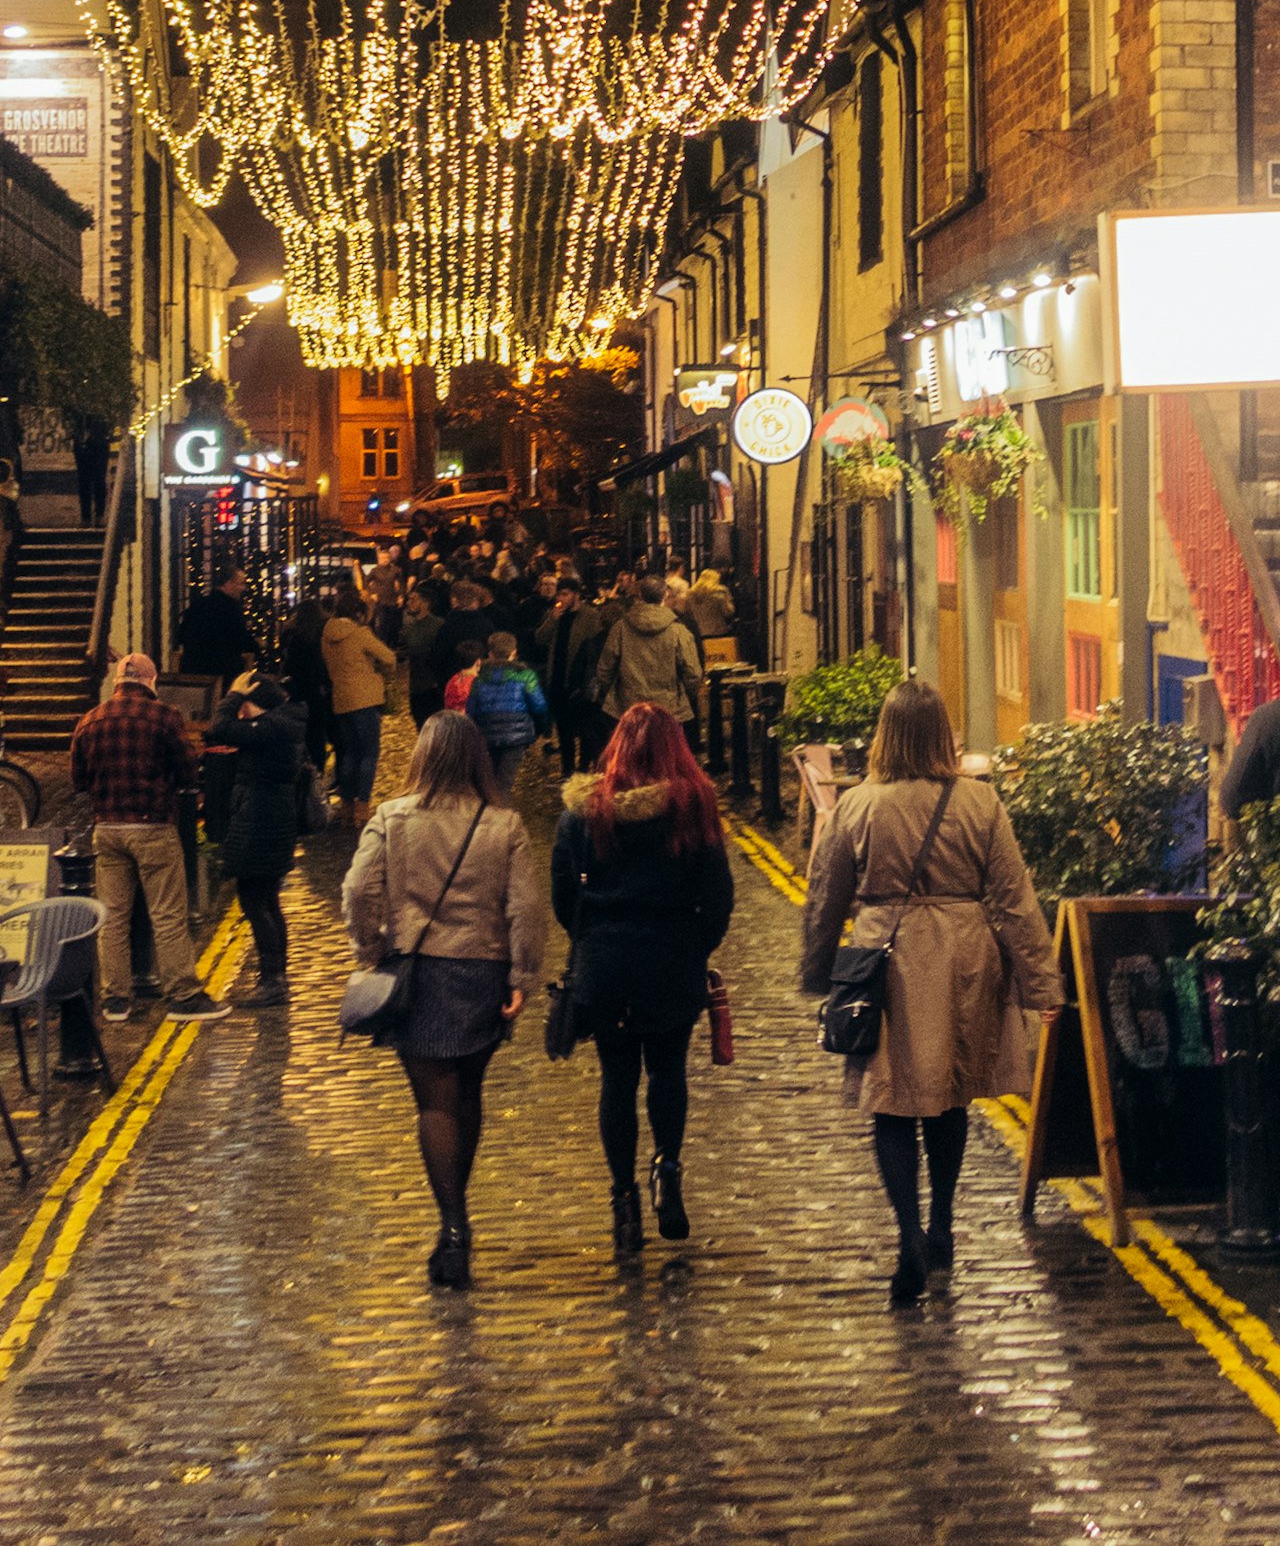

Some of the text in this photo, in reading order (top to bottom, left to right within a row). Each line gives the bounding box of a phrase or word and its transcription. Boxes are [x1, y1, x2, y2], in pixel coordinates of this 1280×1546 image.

[4, 108, 87, 131] GROSVENOR
[30, 134, 86, 154] THEATRE
[174, 429, 221, 475] G
[7, 848, 46, 857] ARRAN
